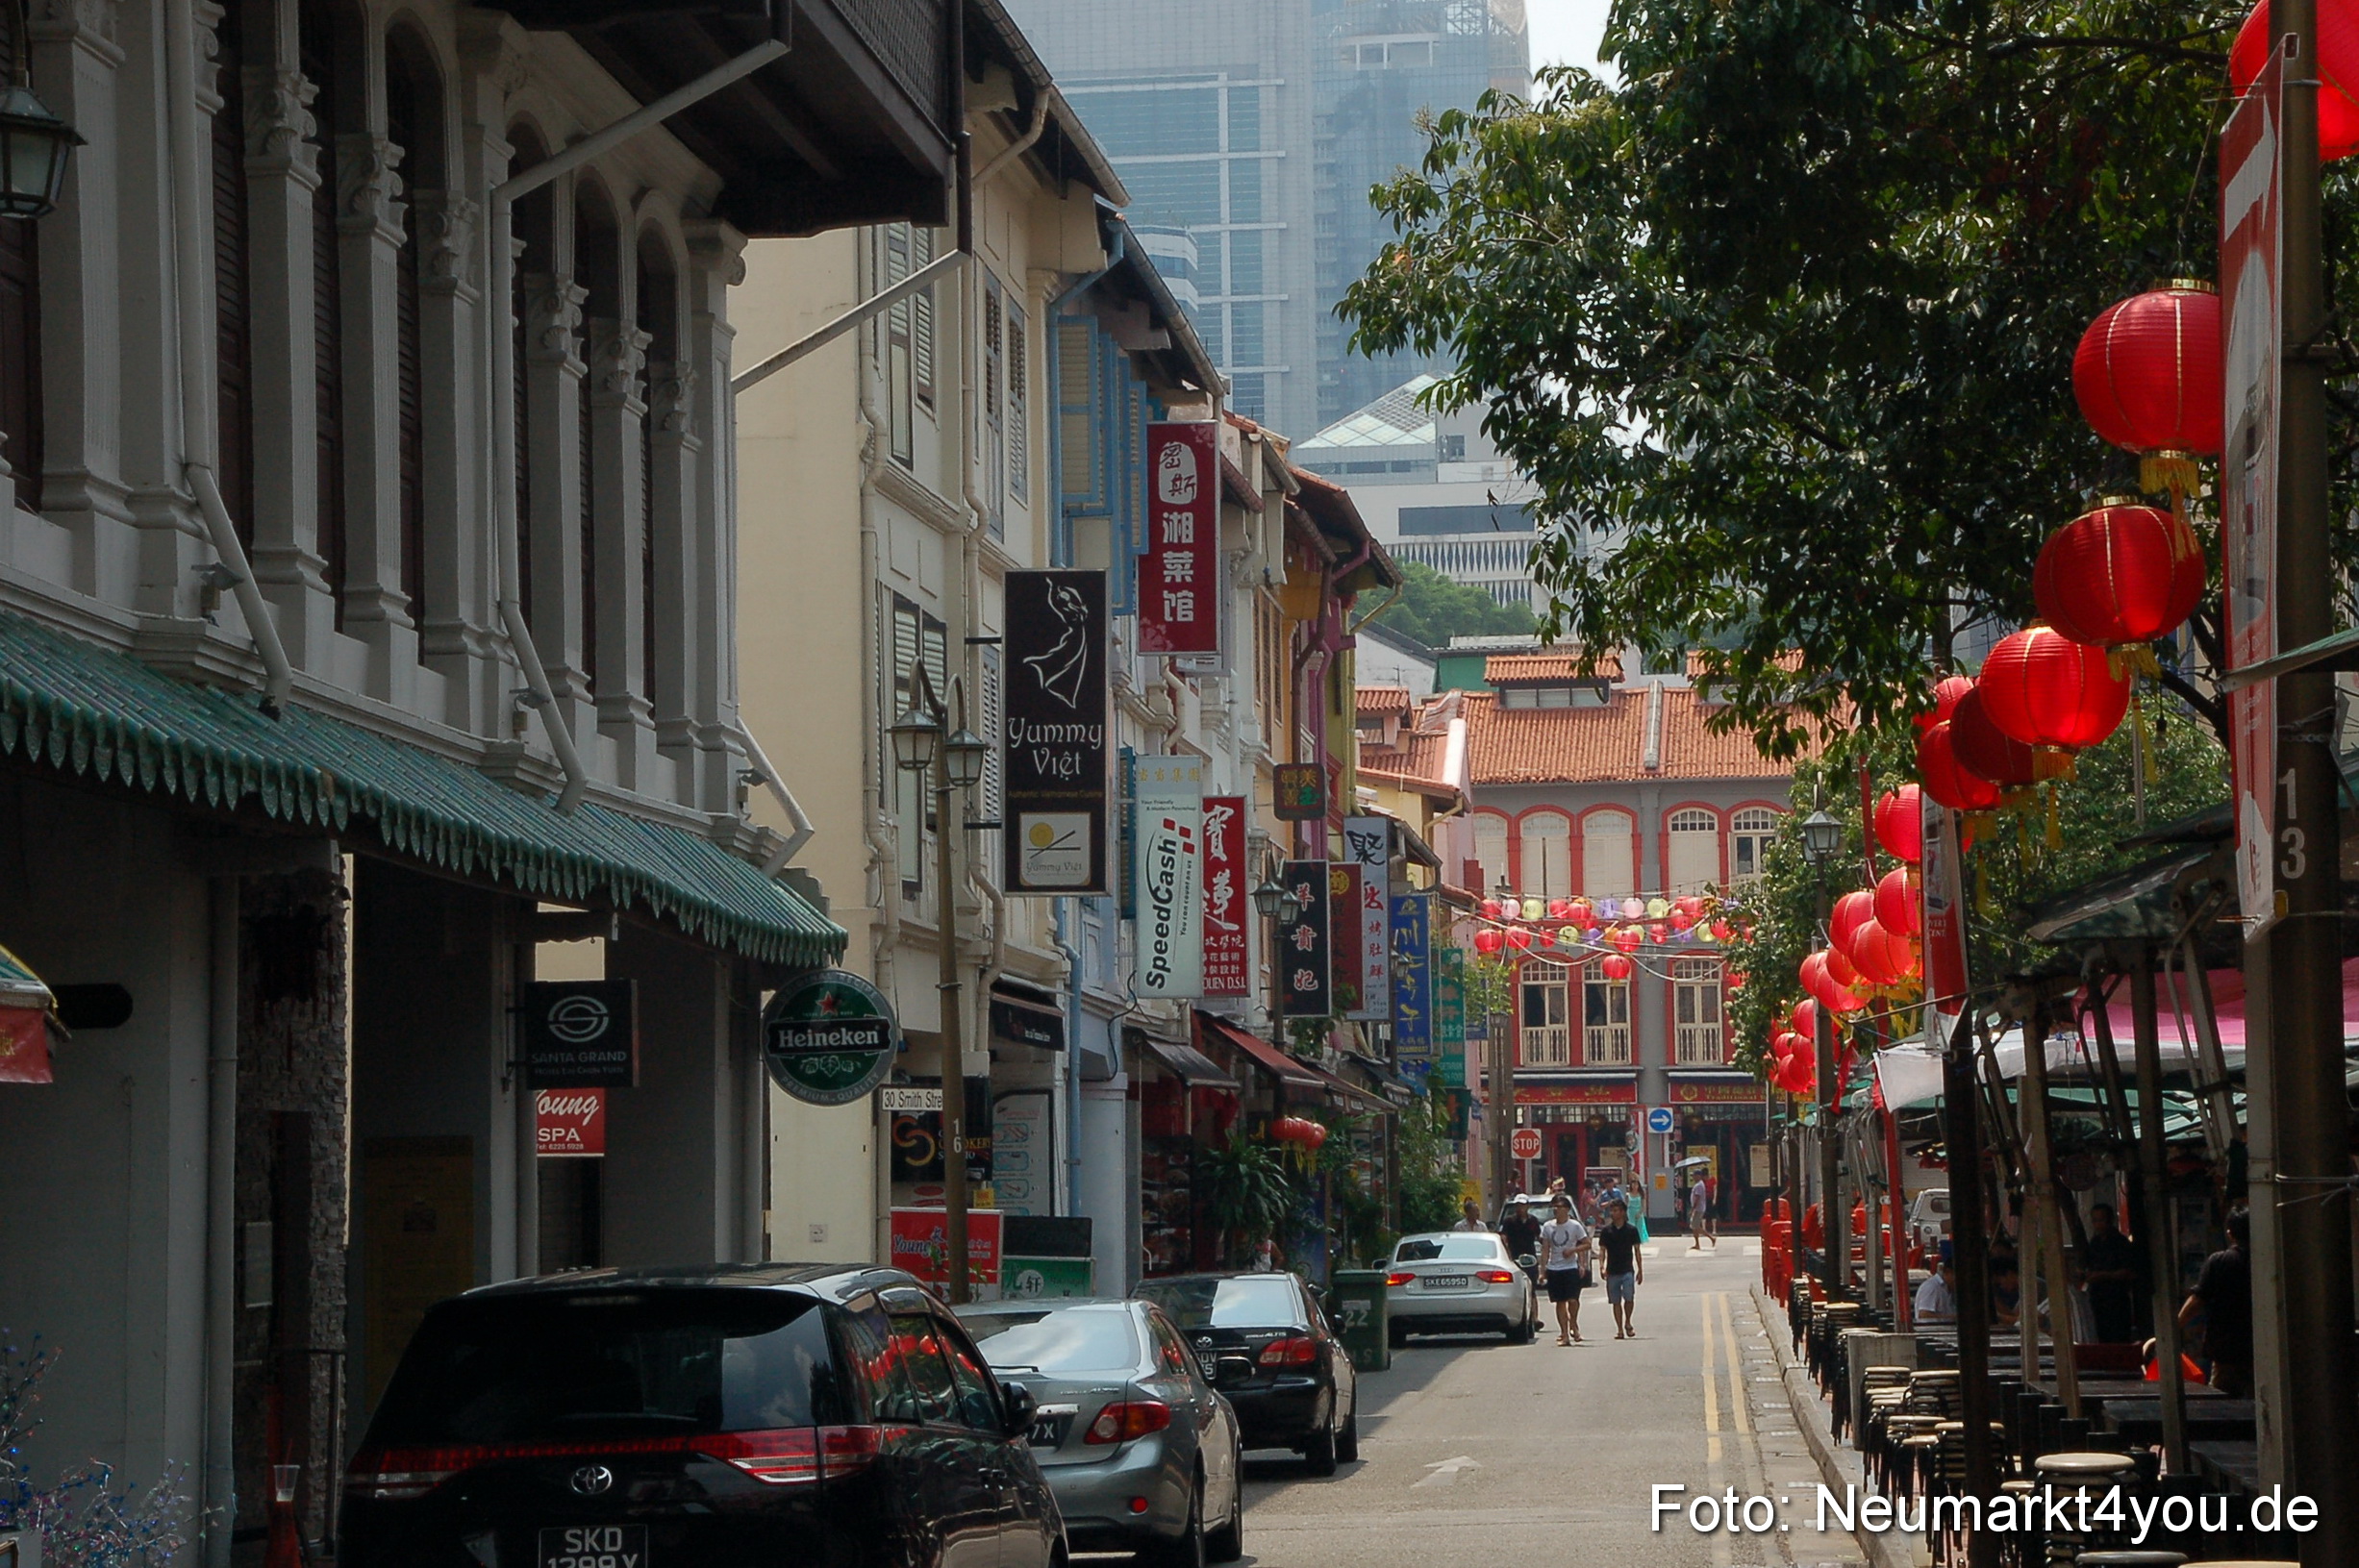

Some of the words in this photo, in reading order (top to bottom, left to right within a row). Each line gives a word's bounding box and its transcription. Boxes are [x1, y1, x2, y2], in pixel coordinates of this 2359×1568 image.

[1163, 511, 1194, 622] 湘菜馆
[1009, 717, 1102, 749] Yummy
[1145, 838, 1177, 990] SpeedCash
[777, 1027, 880, 1048] Heineken
[530, 1052, 575, 1063] SANTA
[577, 1050, 628, 1062] GRAND
[885, 1091, 894, 1108] 30
[898, 1091, 922, 1108] Smith
[925, 1091, 942, 1108] Stre
[539, 1128, 581, 1142] SPA
[1513, 1137, 1540, 1150] STOP
[565, 1527, 623, 1554] SKD
